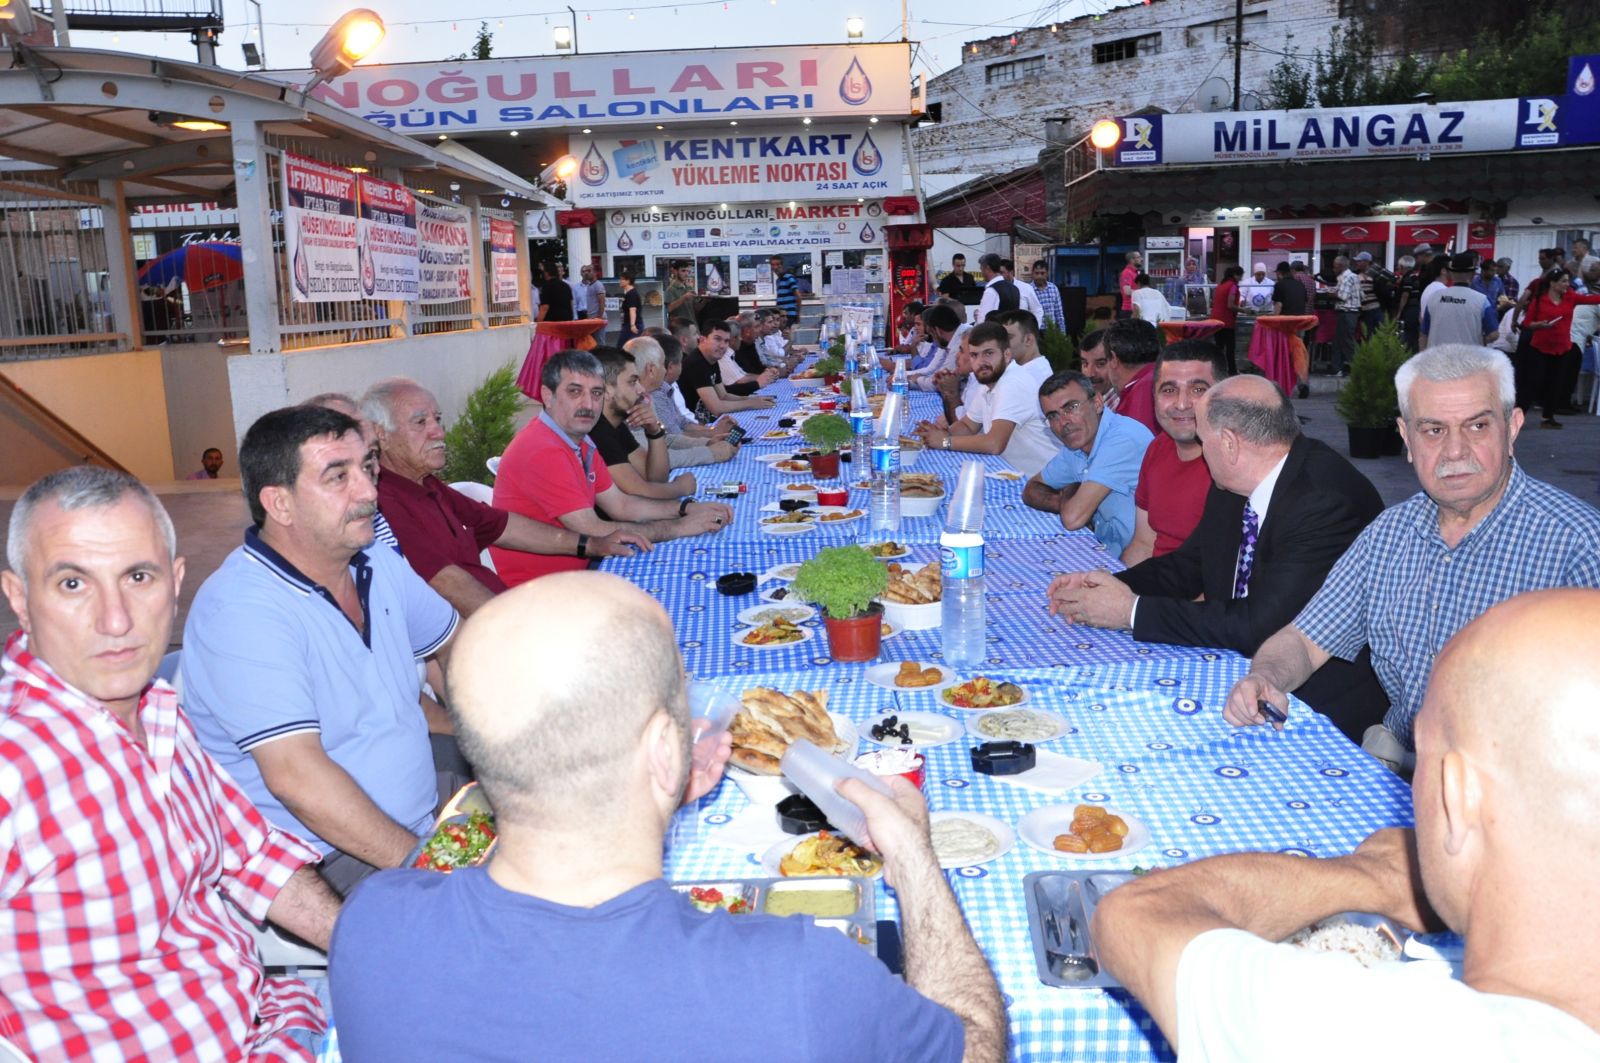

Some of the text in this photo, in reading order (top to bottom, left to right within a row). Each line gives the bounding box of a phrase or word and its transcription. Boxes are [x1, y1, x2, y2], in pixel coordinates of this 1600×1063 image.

[499, 93, 815, 123] SALONLARI
[664, 134, 852, 161] KENTKART
[291, 166, 323, 193] İFTARA
[324, 178, 351, 199] DAVET
[671, 162, 847, 187] YÜKLEME NOKTASI
[832, 182, 859, 190] SAAT
[862, 181, 888, 190] AÇIK
[631, 204, 864, 223] HÜSEYİNOĞULLARI MARKET
[733, 238, 831, 247] YAPILMAKTADIR
[1440, 295, 1467, 305] Nikon
